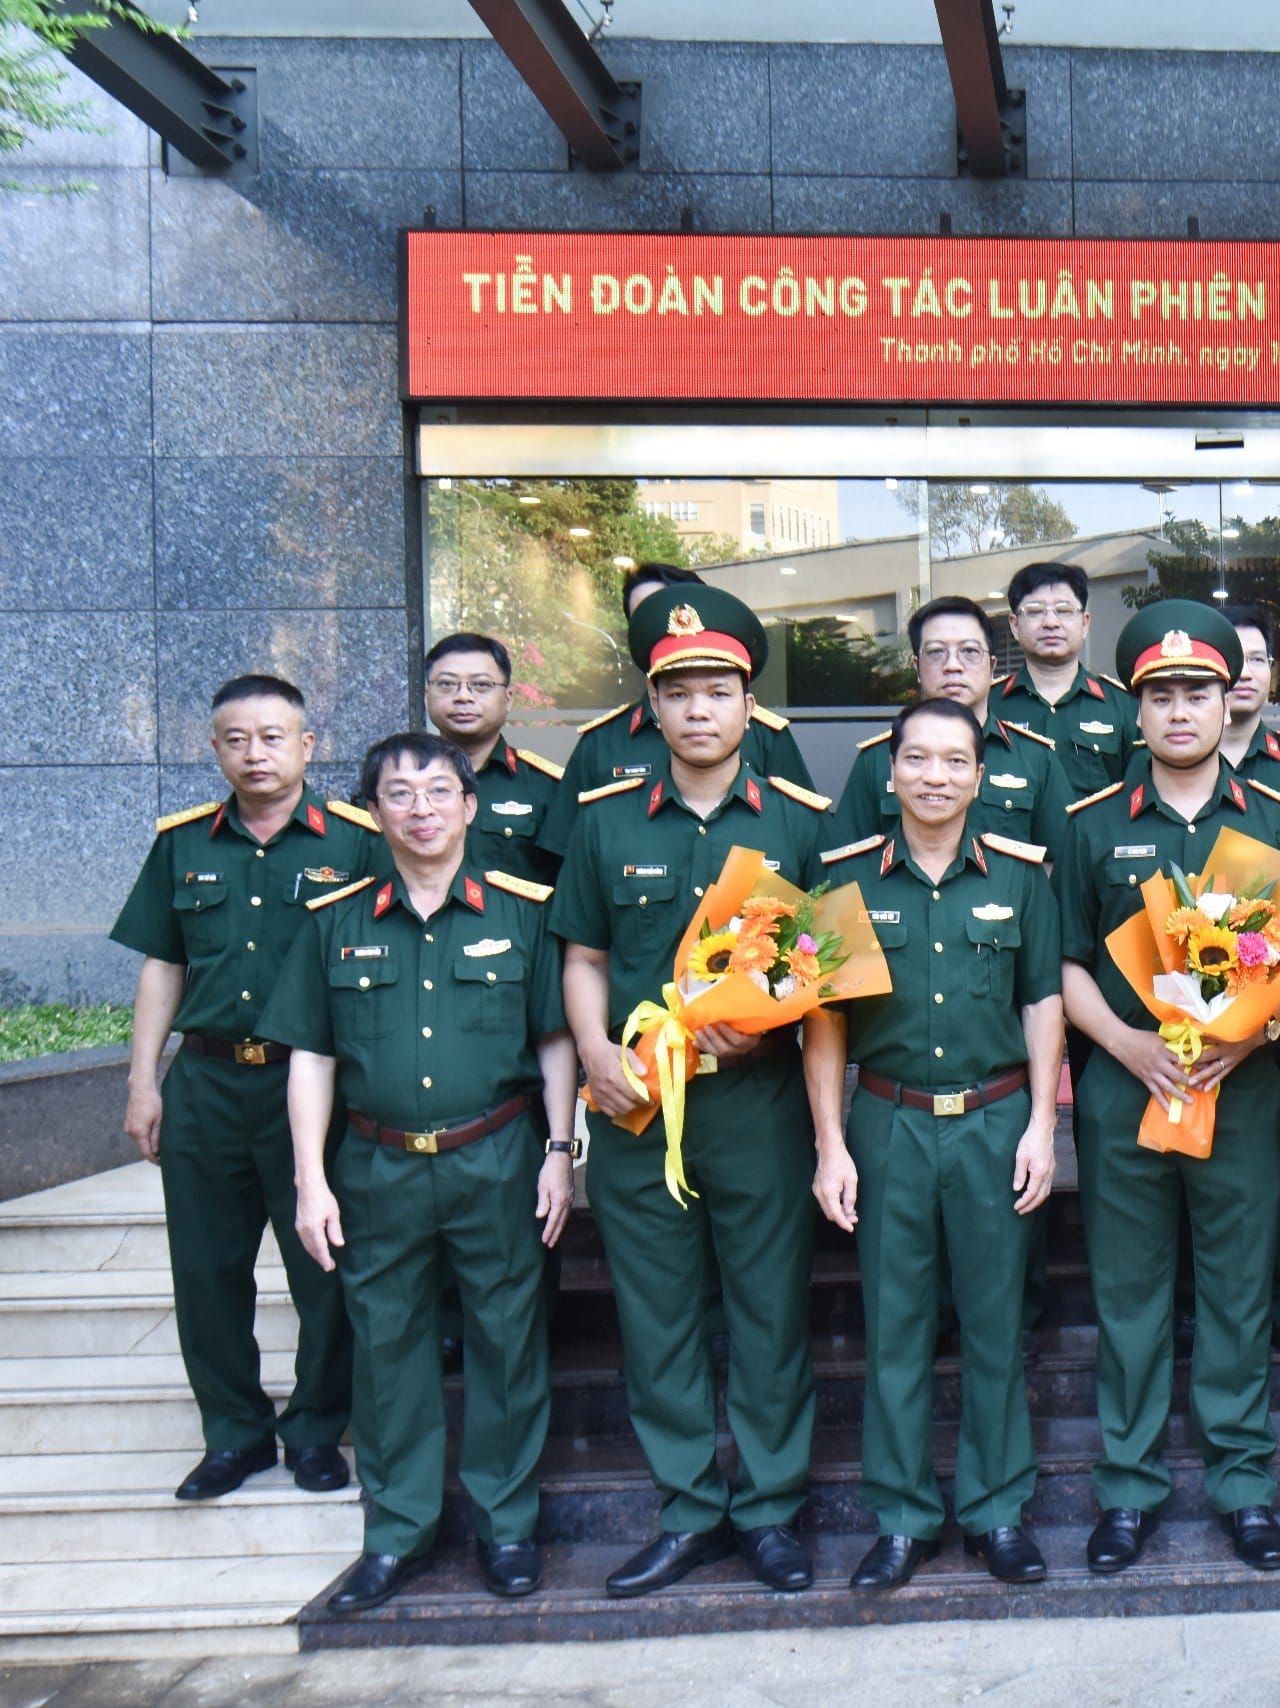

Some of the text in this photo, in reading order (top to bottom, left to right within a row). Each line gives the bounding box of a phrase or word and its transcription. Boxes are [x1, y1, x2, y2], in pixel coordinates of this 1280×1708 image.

[590, 264, 724, 316] ĐOÀN
[739, 266, 868, 318] CÔNG
[882, 266, 973, 319] TÁC
[990, 268, 1114, 320] LUÂN
[1132, 271, 1266, 321] PHIÊN
[1122, 338, 1190, 368] Minh,
